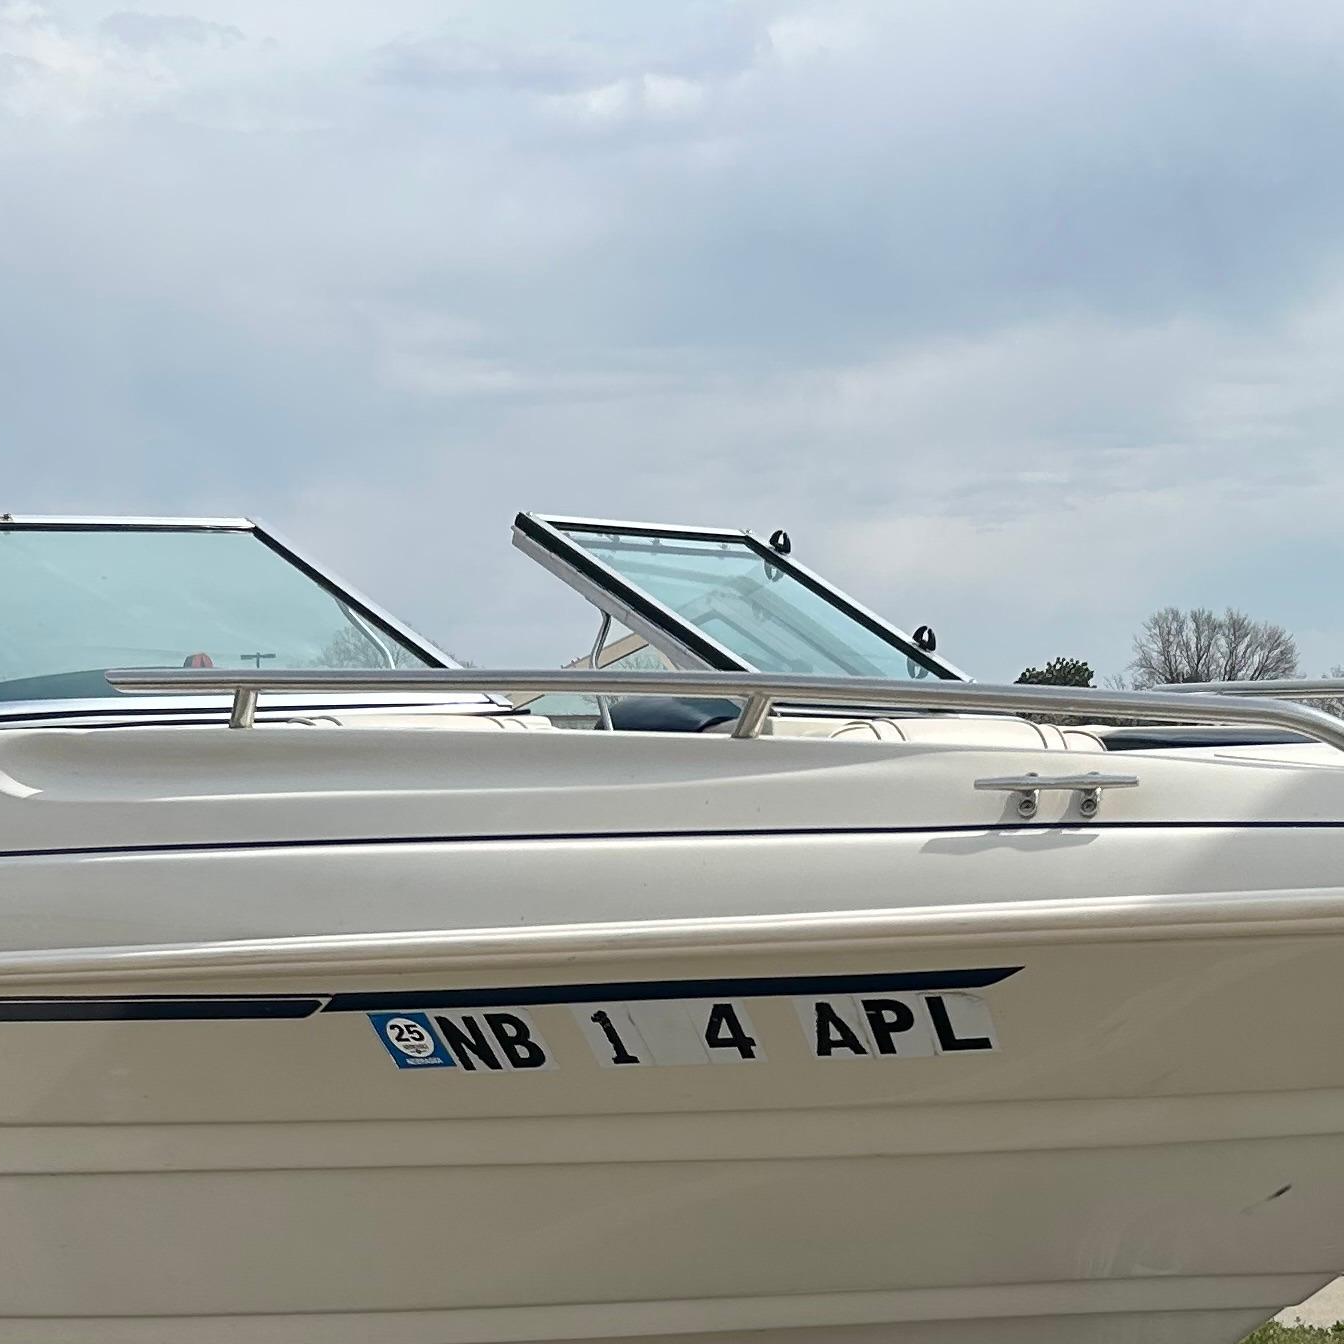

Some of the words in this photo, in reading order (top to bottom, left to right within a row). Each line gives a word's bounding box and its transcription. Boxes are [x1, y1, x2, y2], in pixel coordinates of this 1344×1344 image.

[389, 1024, 425, 1043] 25
[434, 1015, 546, 1071] NB
[814, 996, 993, 1057] APL
